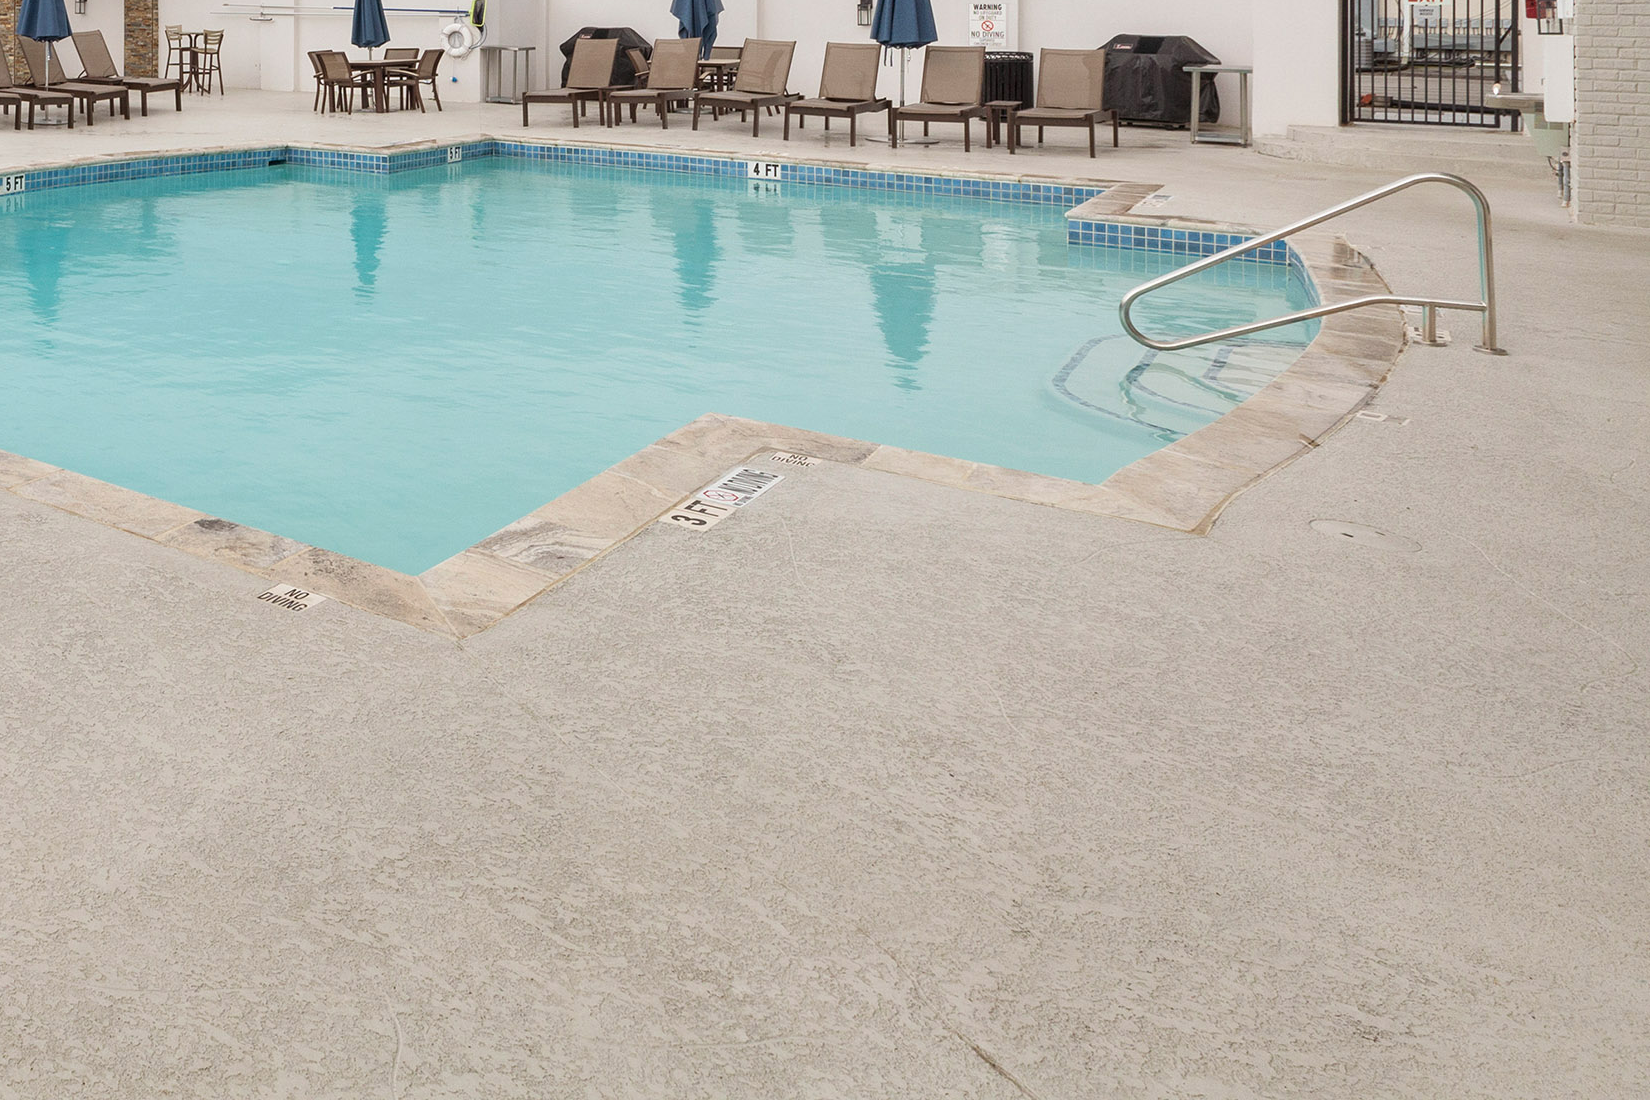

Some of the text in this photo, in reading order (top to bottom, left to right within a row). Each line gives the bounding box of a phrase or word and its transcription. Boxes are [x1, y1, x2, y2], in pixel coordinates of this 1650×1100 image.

[450, 146, 460, 159] 5 FT
[753, 162, 779, 177] 4 FT
[6, 175, 24, 191] 5 FT
[684, 500, 728, 517] FT
[671, 514, 707, 526] 3
[257, 591, 308, 611] DIVING
[284, 588, 310, 600] NO
